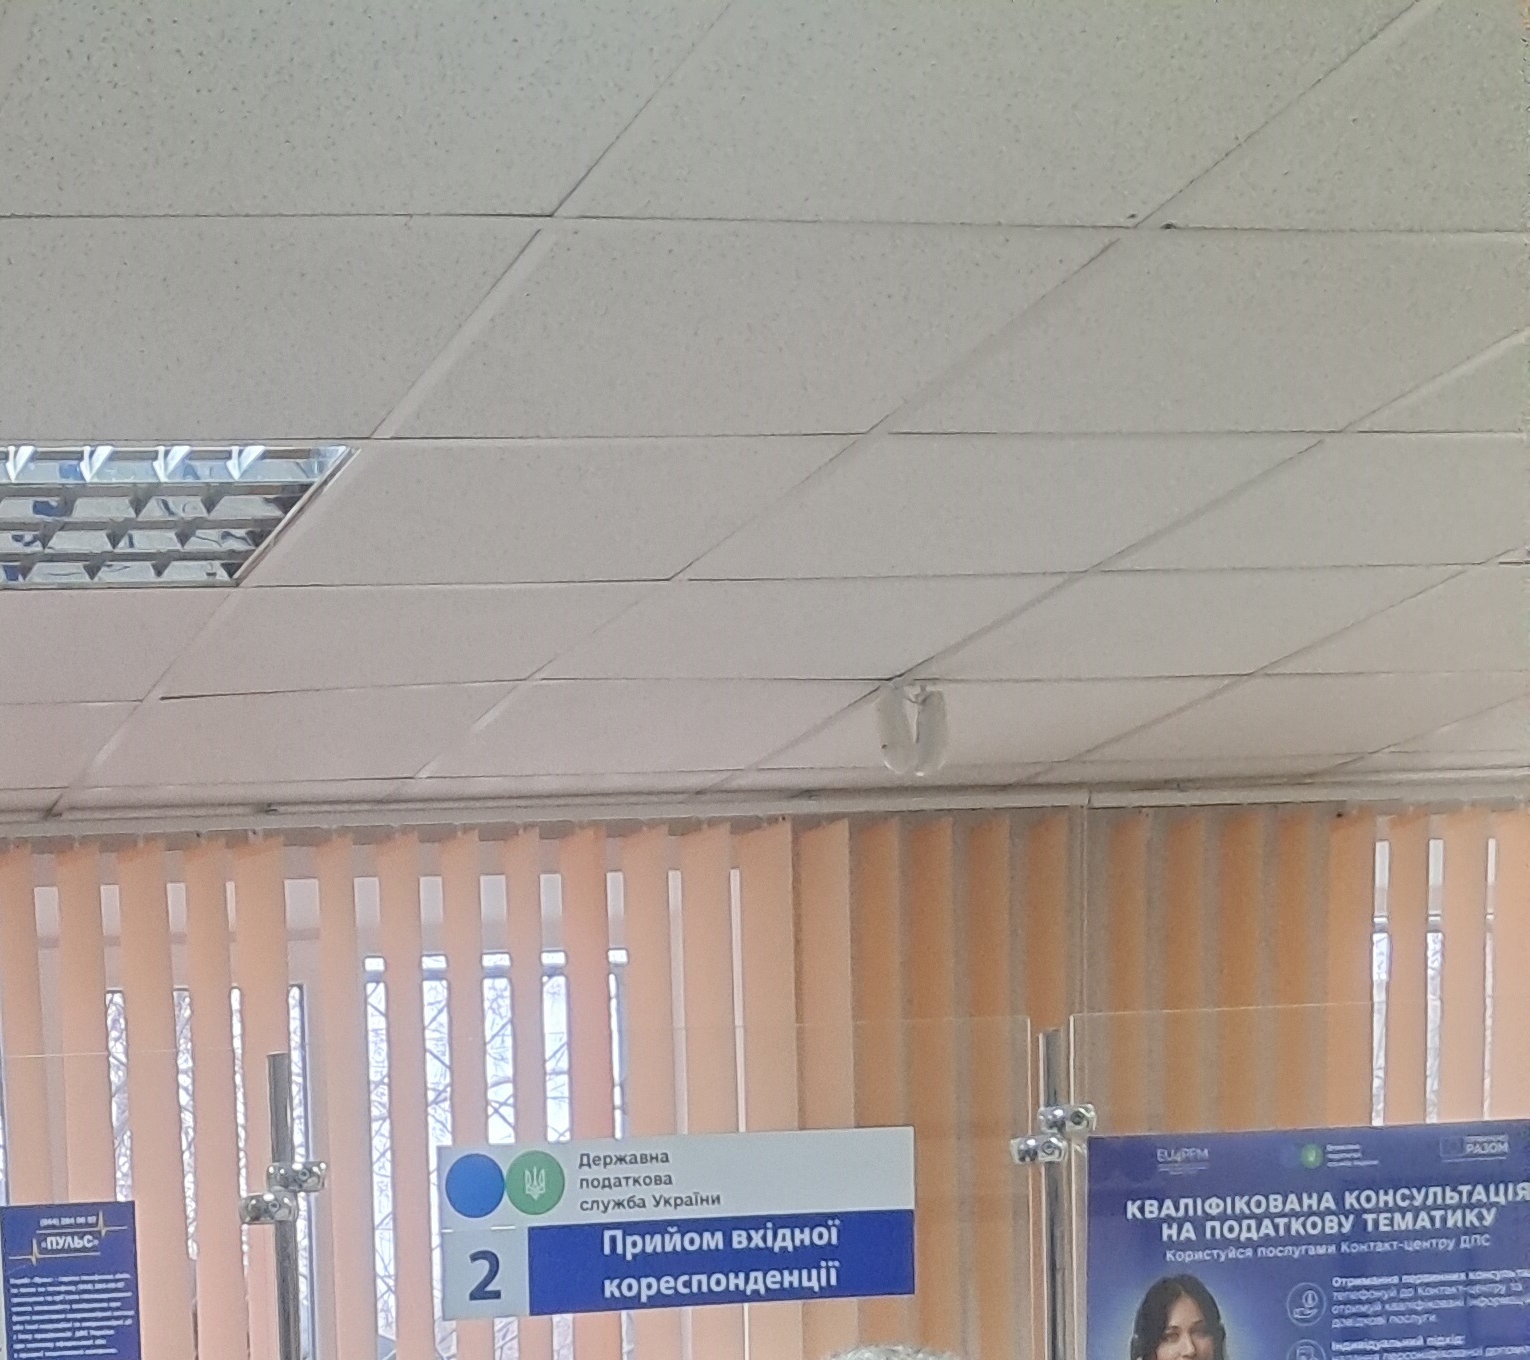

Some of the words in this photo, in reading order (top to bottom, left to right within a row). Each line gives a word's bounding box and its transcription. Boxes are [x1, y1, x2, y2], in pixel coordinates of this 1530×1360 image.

[578, 1149, 670, 1170] Державна
[579, 1172, 673, 1192] податкова
[579, 1194, 647, 1212] служба
[652, 1192, 721, 1211] України
[1126, 1191, 1335, 1221] КВАЛІФІКОВАНА
[1343, 1181, 1530, 1210] КОНСУЛЬТАЦІЯ
[602, 1227, 724, 1261] Прийом
[731, 1218, 841, 1250] вхідної
[1161, 1221, 1197, 1242] НА
[1205, 1213, 1355, 1242] ПОДАТКОВУ
[1362, 1207, 1497, 1233] ТЕМАТИКУ
[1165, 1246, 1253, 1264] Користуйся
[1258, 1243, 1337, 1260] послугами
[1340, 1237, 1456, 1256] Контакт-центру
[1460, 1233, 1491, 1249] ДПС
[467, 1249, 503, 1302] 2
[604, 1260, 840, 1303] кореспонденції
